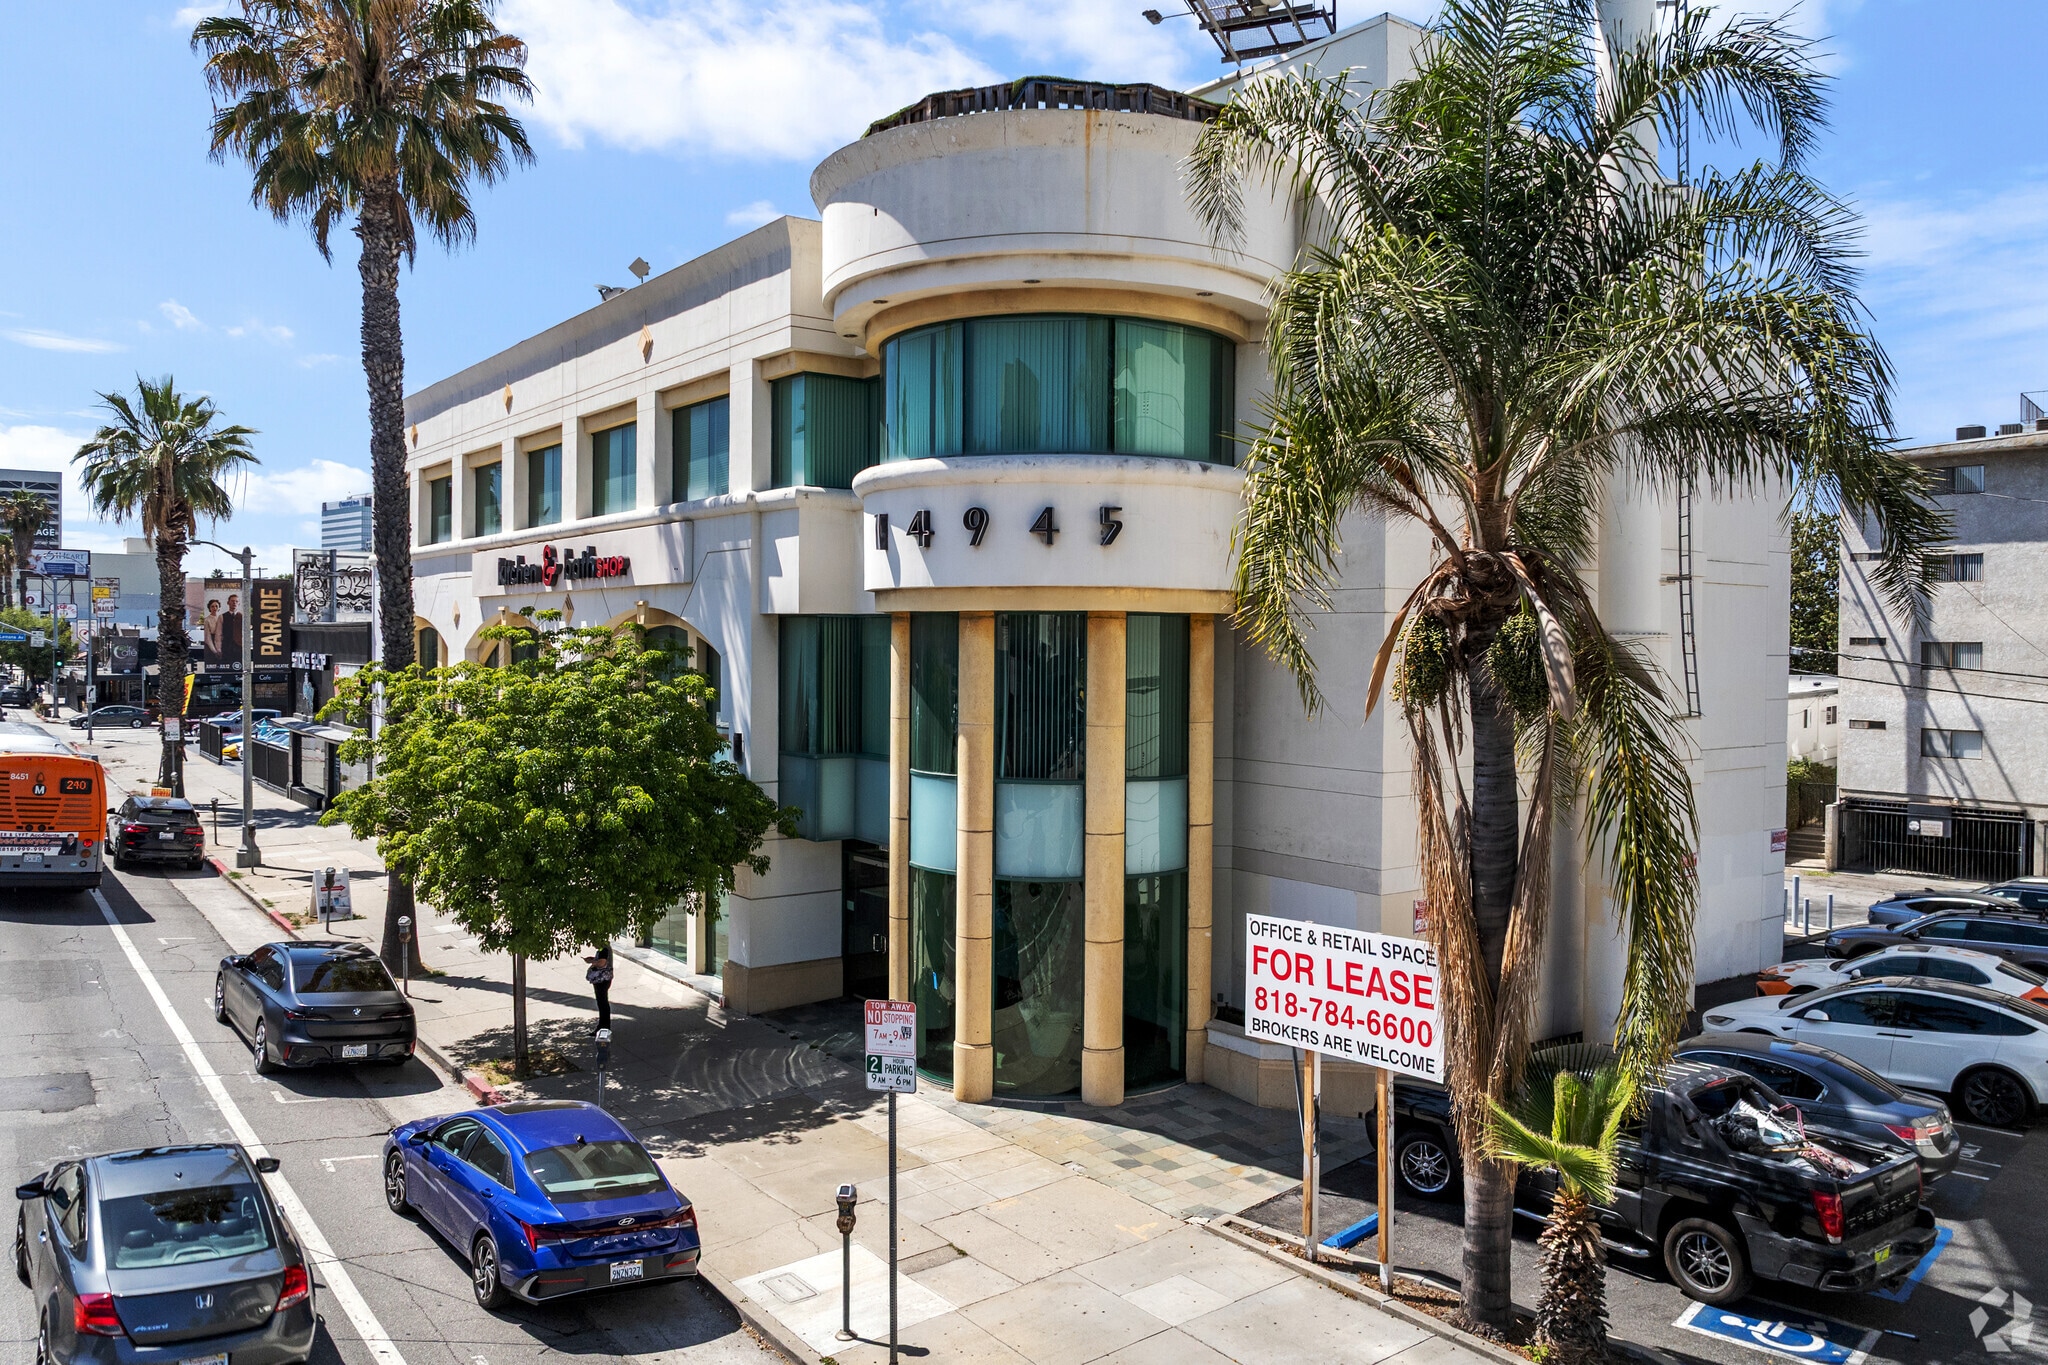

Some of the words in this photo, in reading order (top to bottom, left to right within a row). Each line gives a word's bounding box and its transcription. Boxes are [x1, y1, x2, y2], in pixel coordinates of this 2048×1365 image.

[34, 529, 55, 537] AGE
[542, 545, 563, 586] &
[596, 556, 630, 577] SHOP
[260, 588, 282, 656] PARADE
[34, 785, 45, 794] M
[66, 780, 87, 790] 240
[1250, 920, 1302, 943] OFFICE
[1307, 929, 1317, 946] &
[1322, 932, 1377, 956] RETAIL
[1381, 942, 1437, 967] SPACE
[1253, 945, 1314, 986] FOR
[1326, 958, 1435, 1010] LEASE
[871, 1002, 887, 1010] TOW
[890, 1003, 911, 1011] AWAY
[867, 1010, 881, 1024] NO
[884, 1013, 913, 1025] STOPPING
[1254, 986, 1433, 1048] 818-784-6600
[1252, 1017, 1319, 1045] BROKERS
[1323, 1034, 1353, 1053] ARE
[1356, 1040, 1435, 1074] WELCOME
[870, 1056, 879, 1072] 2
[885, 1063, 913, 1076] PARKING
[594, 1233, 656, 1245] ELANTRA
[612, 1266, 641, 1279] 9NZN327
